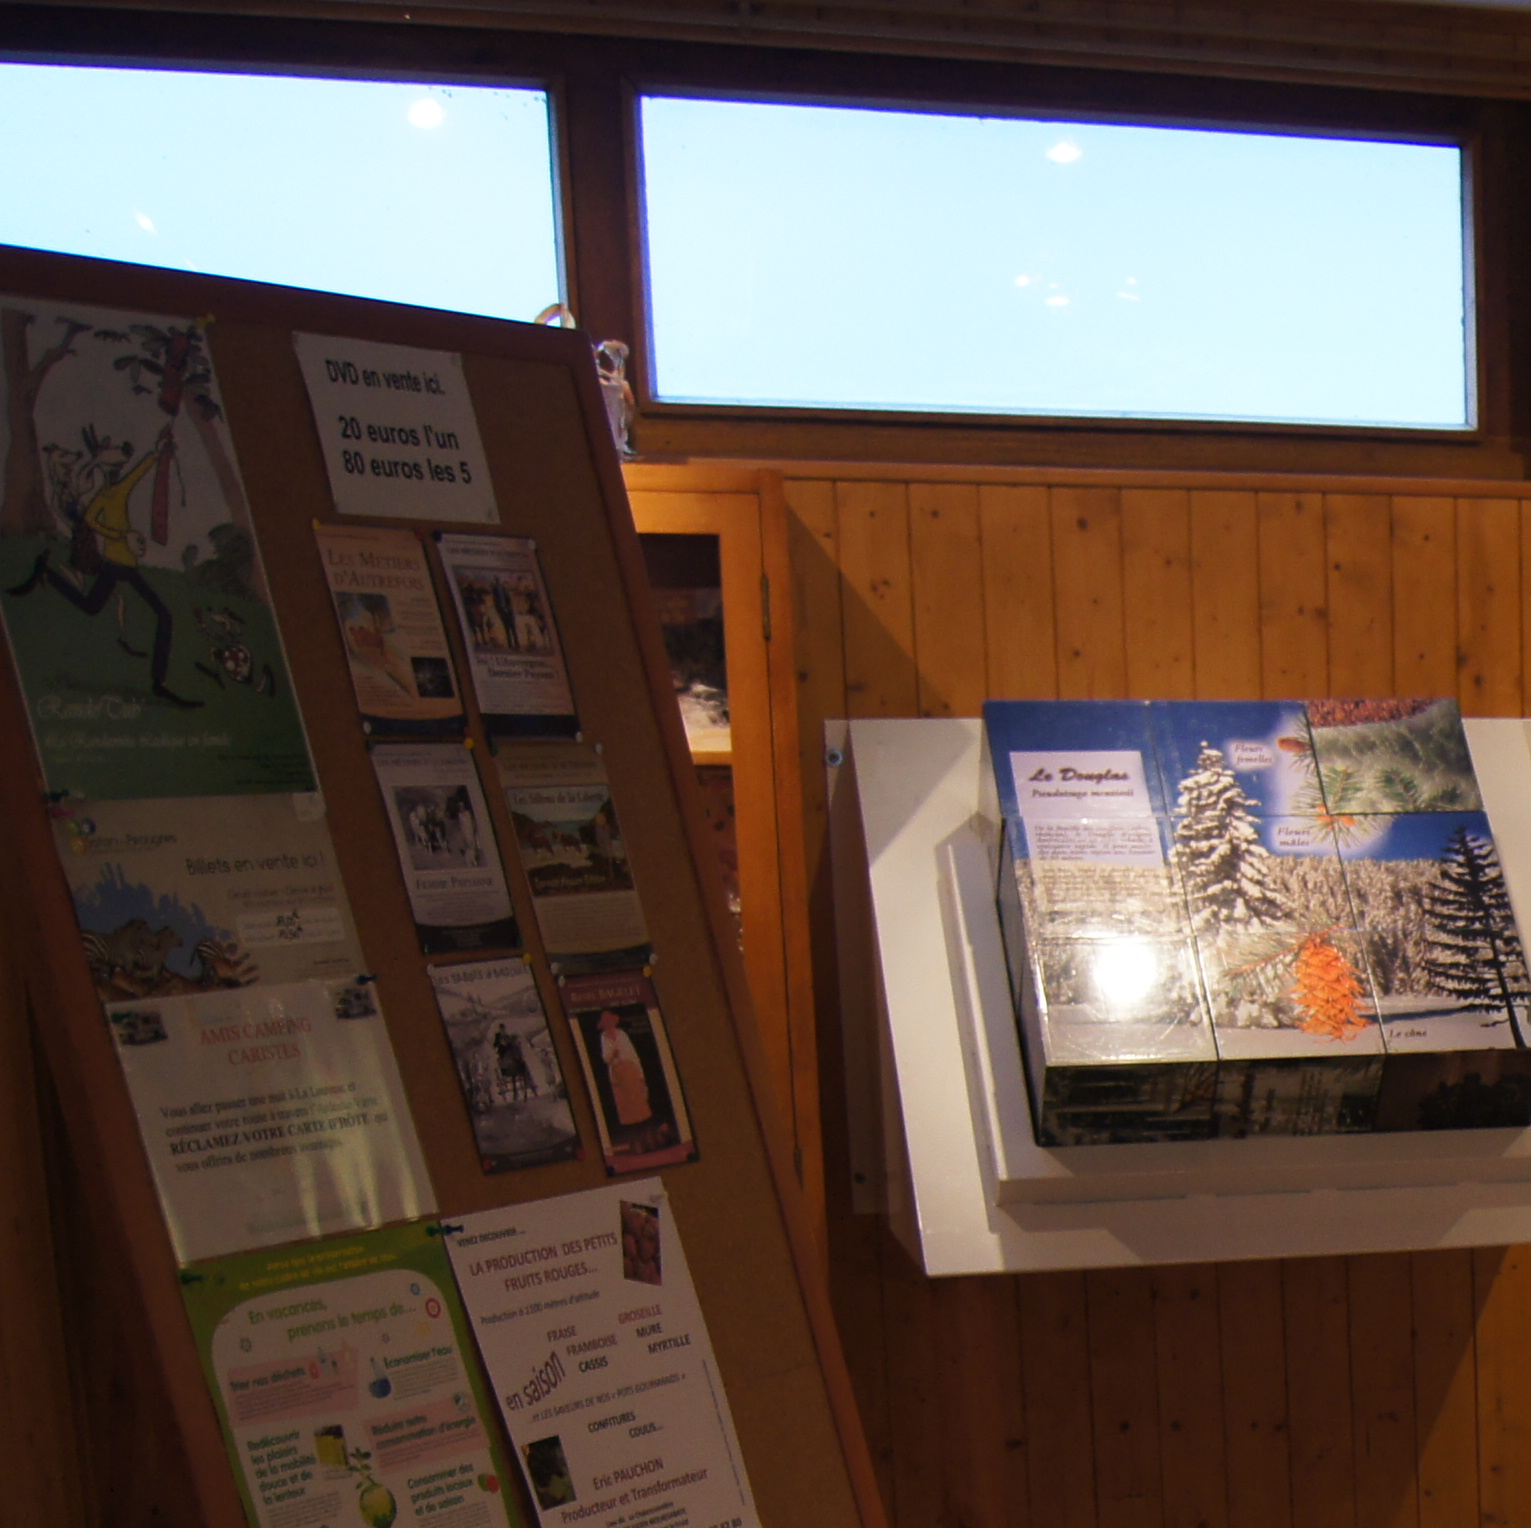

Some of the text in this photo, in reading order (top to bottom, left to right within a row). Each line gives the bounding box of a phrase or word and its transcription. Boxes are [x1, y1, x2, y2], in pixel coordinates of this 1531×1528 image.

[325, 359, 445, 395] DVD en vente ici.
[339, 416, 458, 449] 20 euros l'un
[343, 451, 472, 484] 80 euros les 5
[186, 854, 298, 876] Billets en vente
[200, 1017, 312, 1046] AMIS CAMPING
[244, 1126, 286, 1143] VOTRE
[469, 1231, 618, 1278] LA PRODUCTION DES PETITS
[504, 1274, 543, 1292] FRUITS
[546, 1325, 577, 1342] FRAISE
[636, 1323, 663, 1339] MURE
[566, 1334, 618, 1357] FRAMBOISE
[647, 1334, 691, 1355] MYRTILLE
[578, 1355, 609, 1373] CASSIS
[505, 1350, 567, 1412] en saison
[588, 1411, 636, 1433] CONFITURES
[593, 1458, 664, 1491] Eric PAUCHON
[561, 1468, 708, 1524] Producteur et Transformateur
